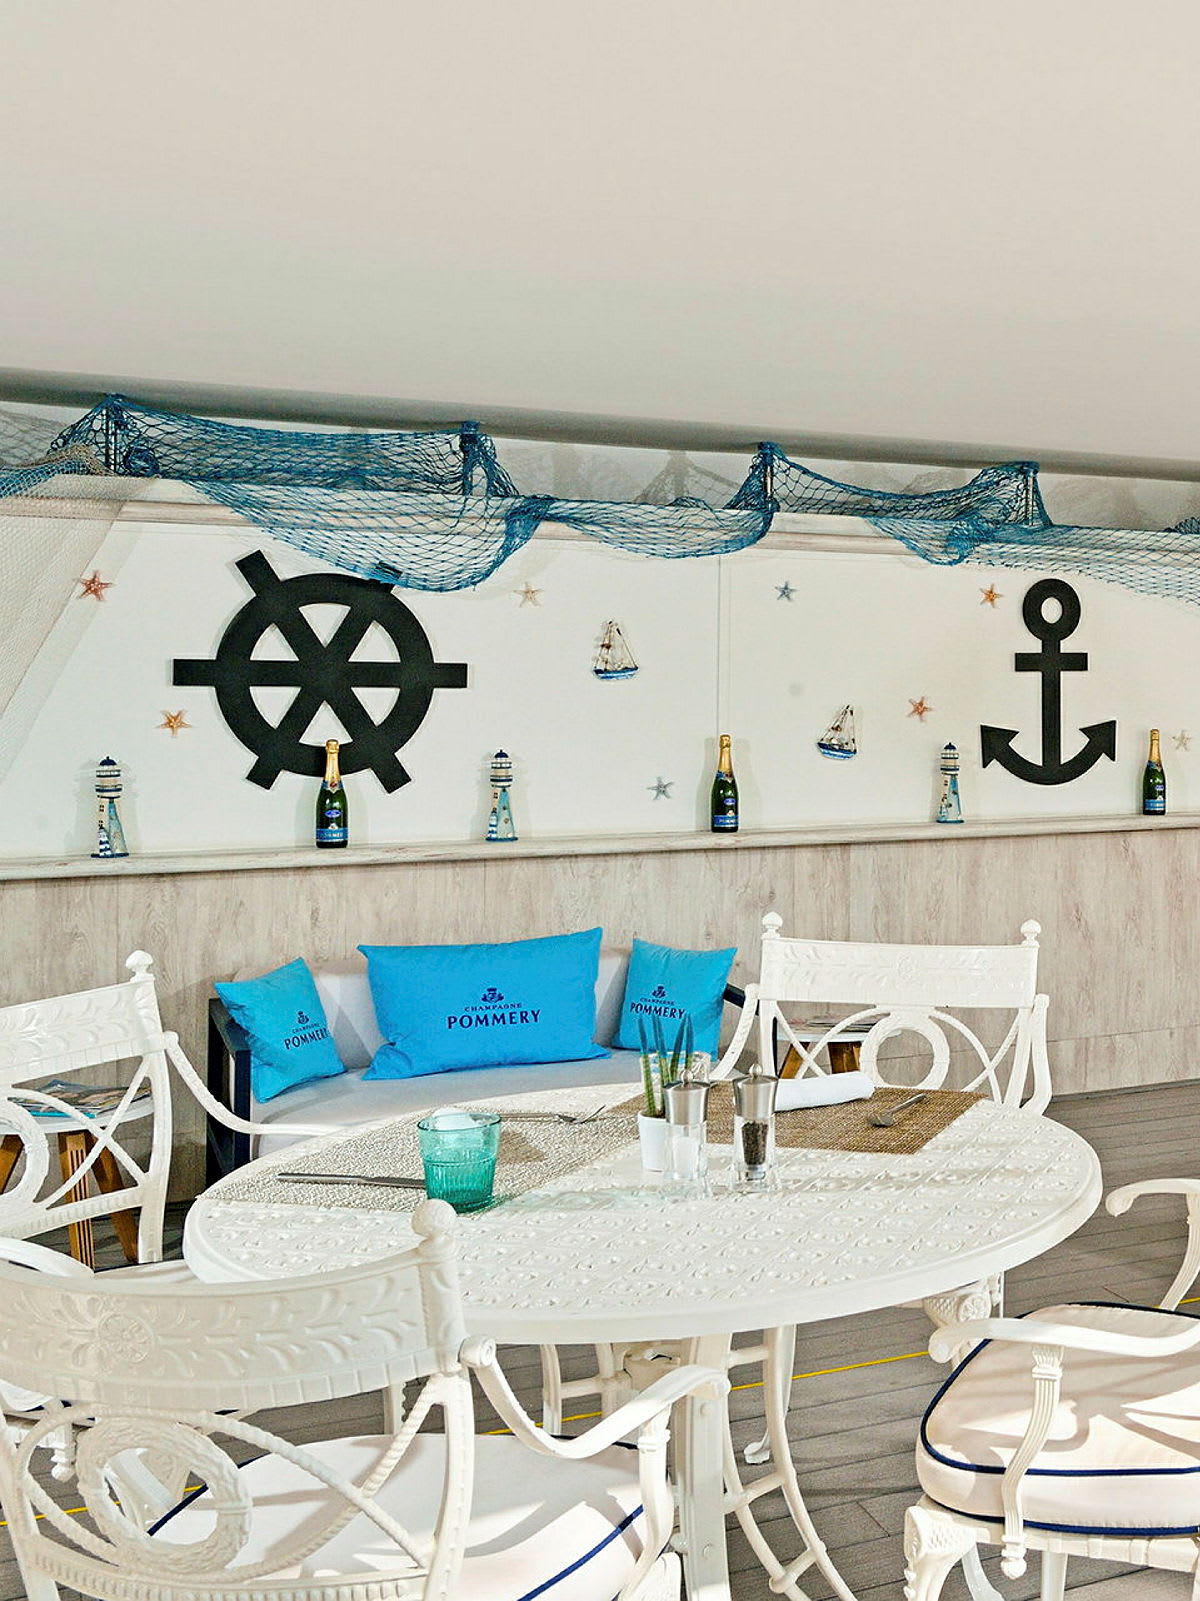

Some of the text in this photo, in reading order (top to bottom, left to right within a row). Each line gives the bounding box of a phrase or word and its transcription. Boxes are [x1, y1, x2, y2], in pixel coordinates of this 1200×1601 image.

[464, 1002, 522, 1013] CHAMPAGNE
[630, 1002, 685, 1019] POMMERY
[447, 1009, 540, 1030] POMMERY
